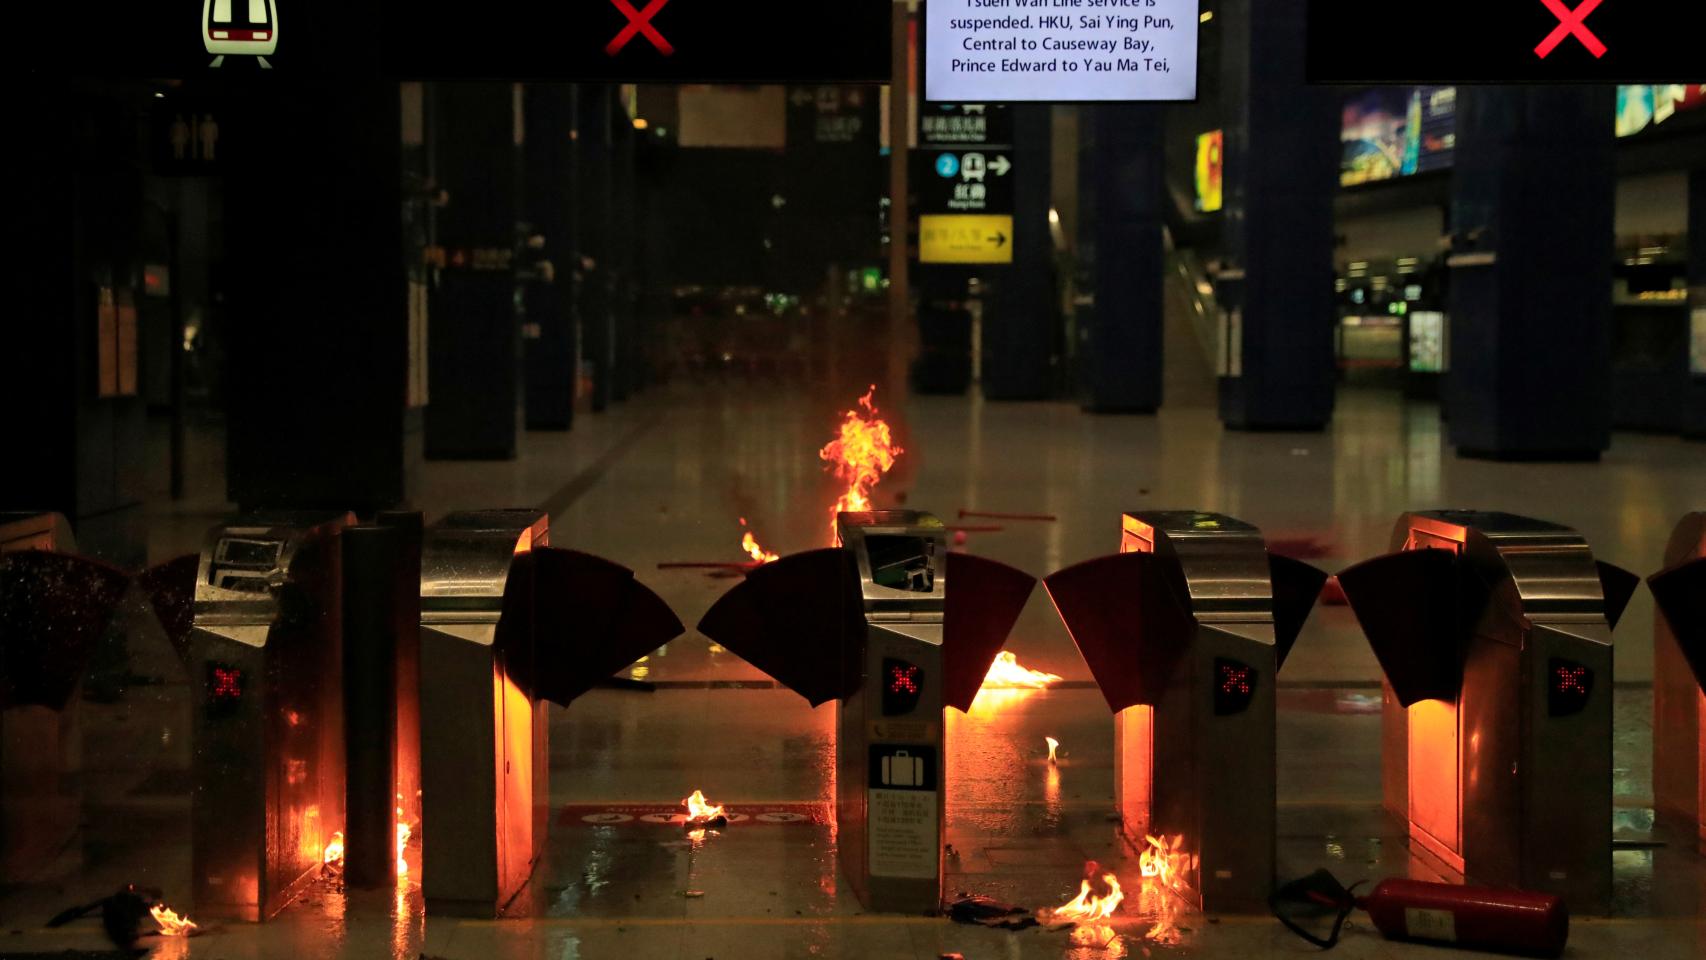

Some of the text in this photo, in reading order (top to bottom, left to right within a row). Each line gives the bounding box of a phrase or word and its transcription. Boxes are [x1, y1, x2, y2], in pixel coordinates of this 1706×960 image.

[949, 14, 1174, 32] suspended. HKU, Sai Ying Pun,
[963, 36, 1154, 54] Central to Causeway Bay,
[952, 57, 1170, 74] Prince Edward to Yau Ma Tei,
